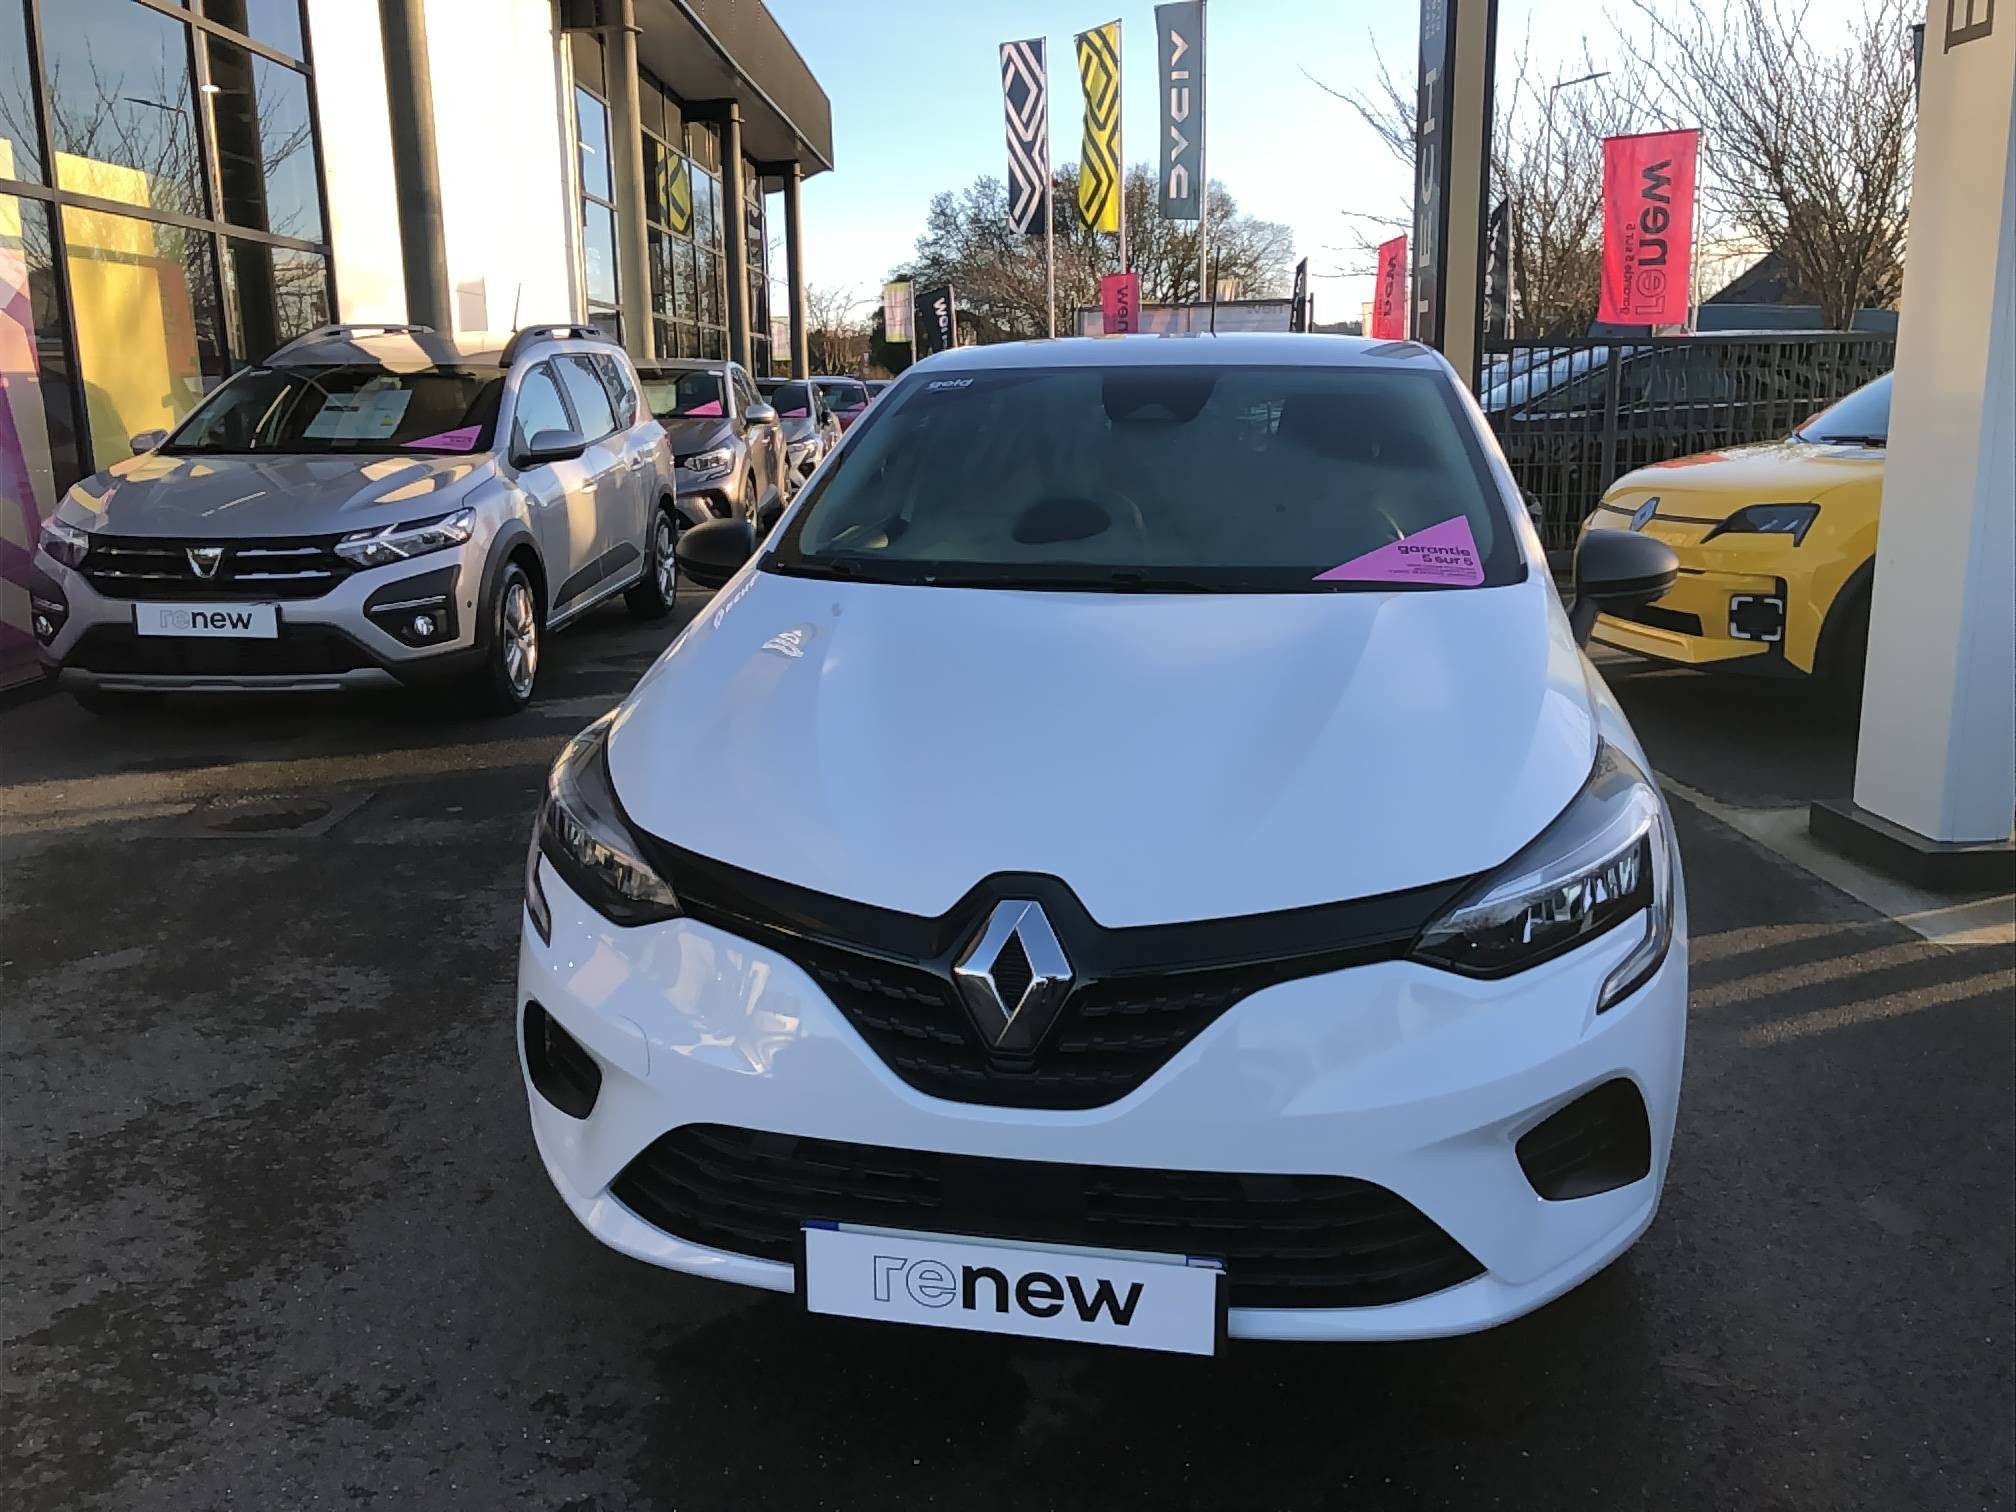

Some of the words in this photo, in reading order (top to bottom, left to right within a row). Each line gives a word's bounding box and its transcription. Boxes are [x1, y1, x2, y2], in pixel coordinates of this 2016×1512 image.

[1398, 546, 1470, 556] garantie
[160, 609, 252, 630] renew
[873, 1255, 1145, 1326] renew
